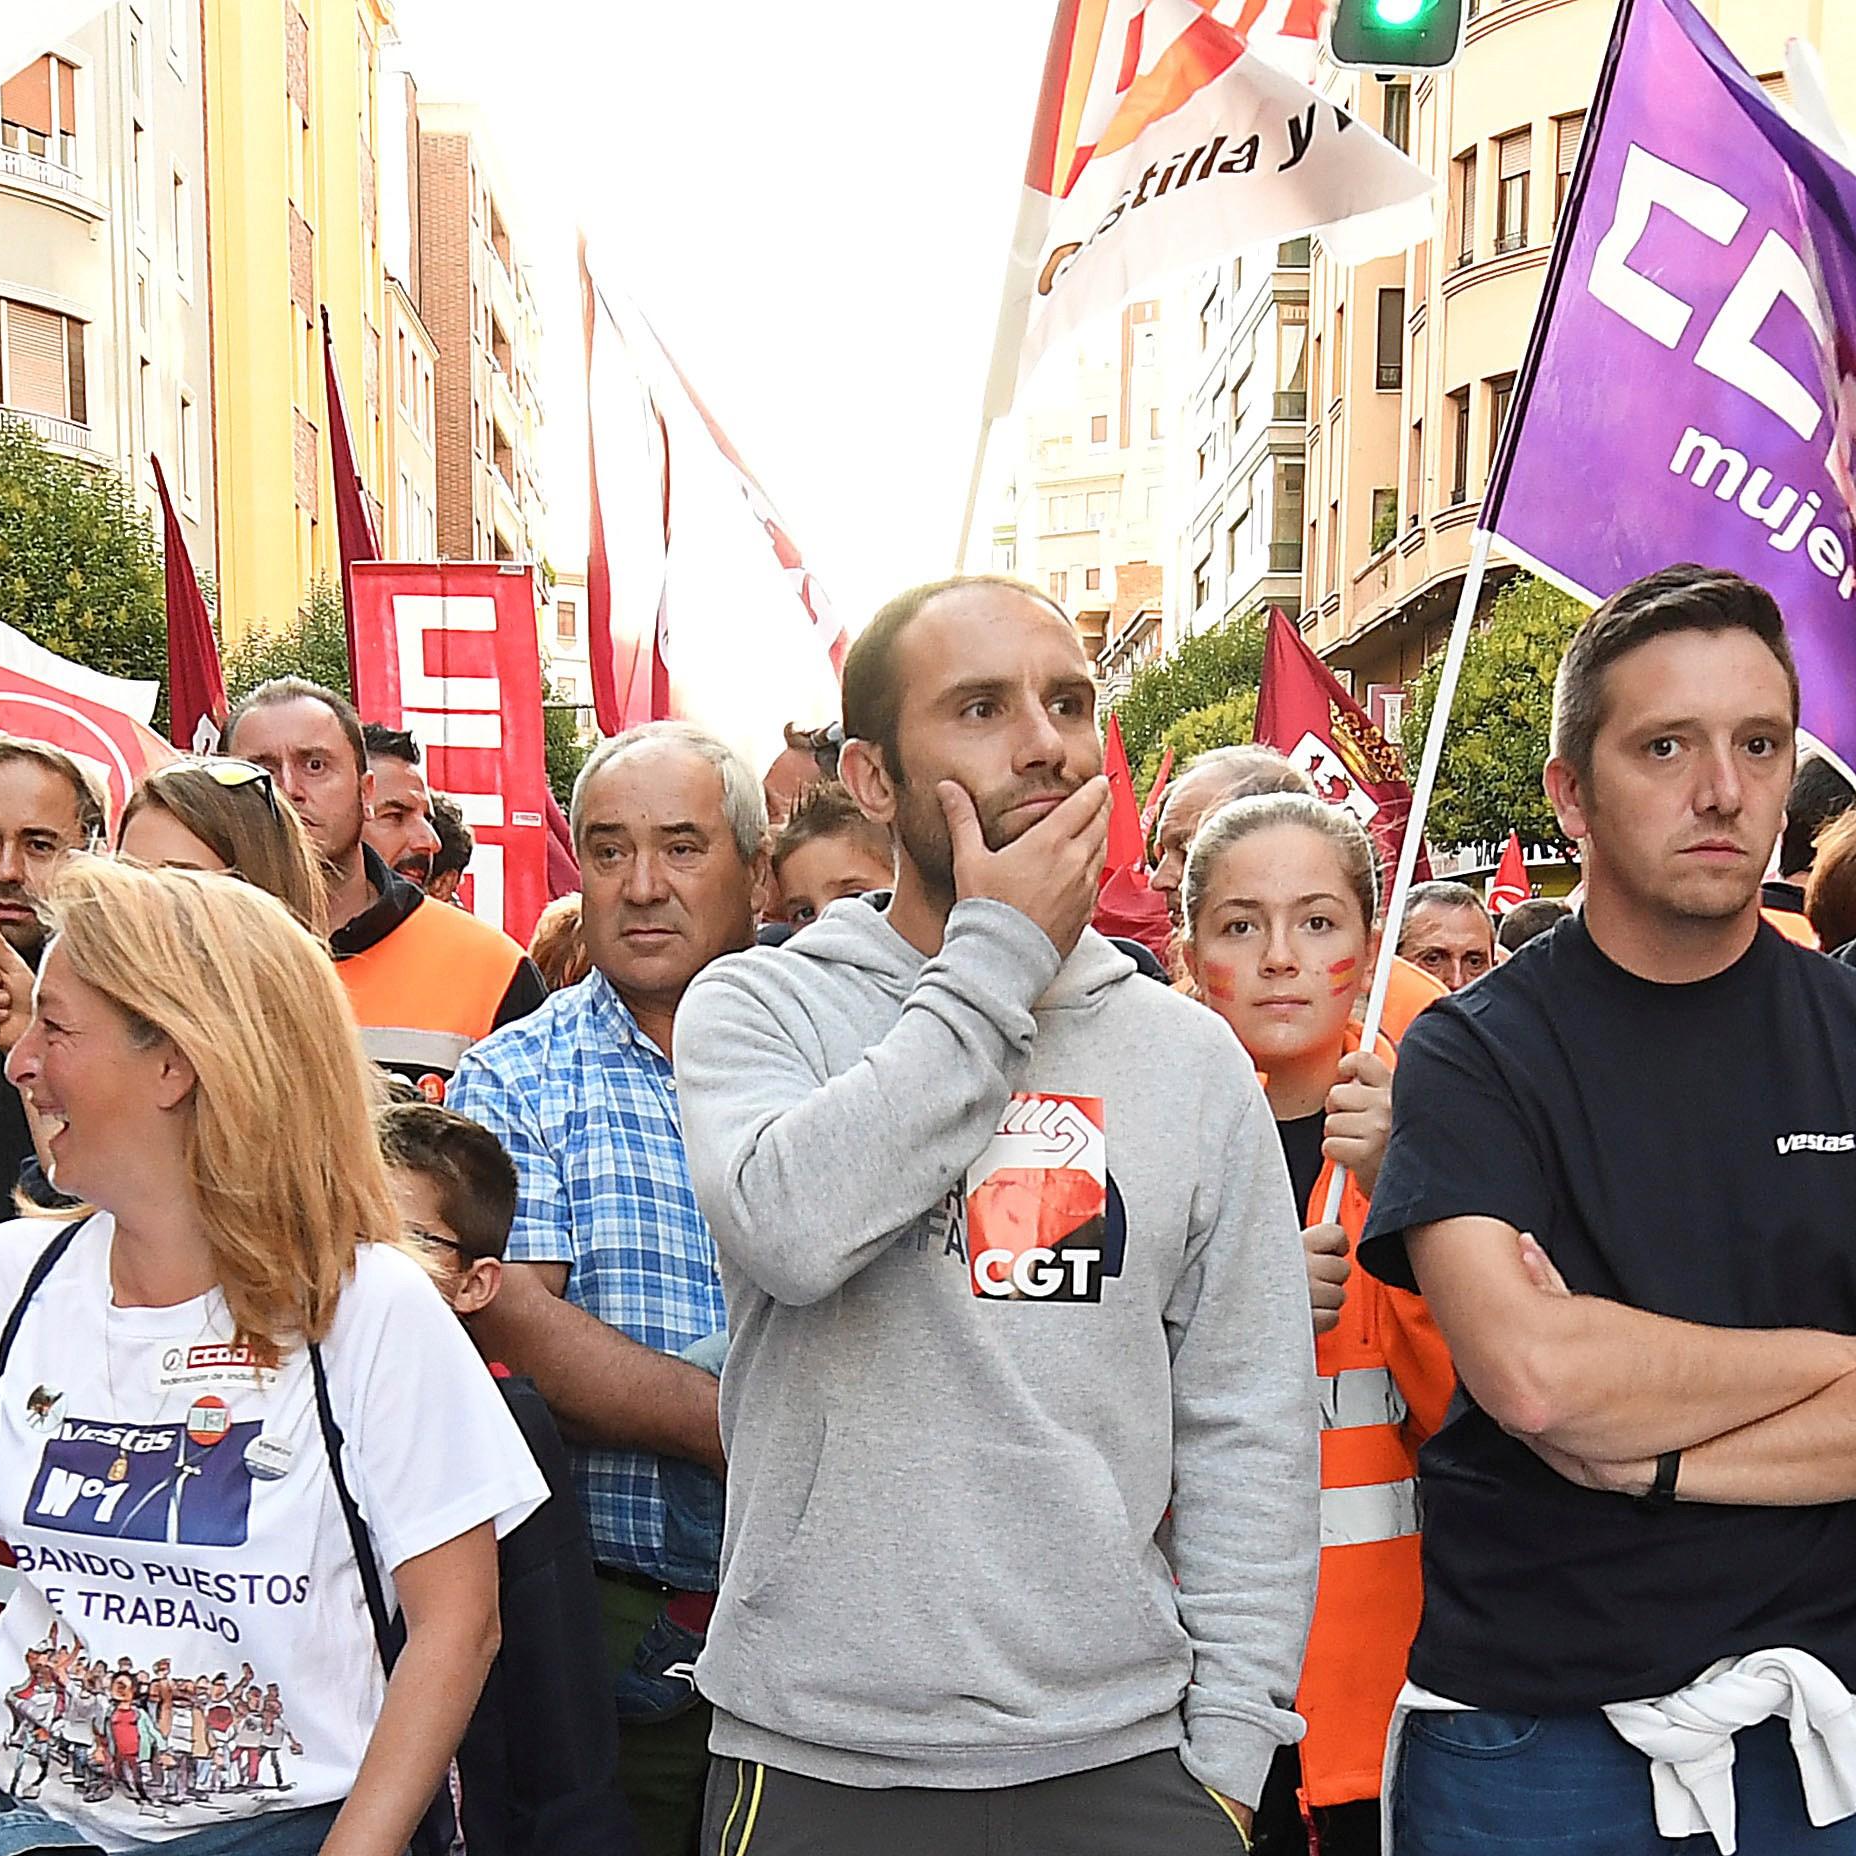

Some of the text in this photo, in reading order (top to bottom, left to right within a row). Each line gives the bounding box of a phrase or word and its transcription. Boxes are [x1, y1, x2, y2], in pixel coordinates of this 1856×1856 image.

[973, 1247, 1101, 1297] CGT
[145, 1563, 311, 1606] PUESTOS
[77, 1591, 241, 1644] TRABAJO
